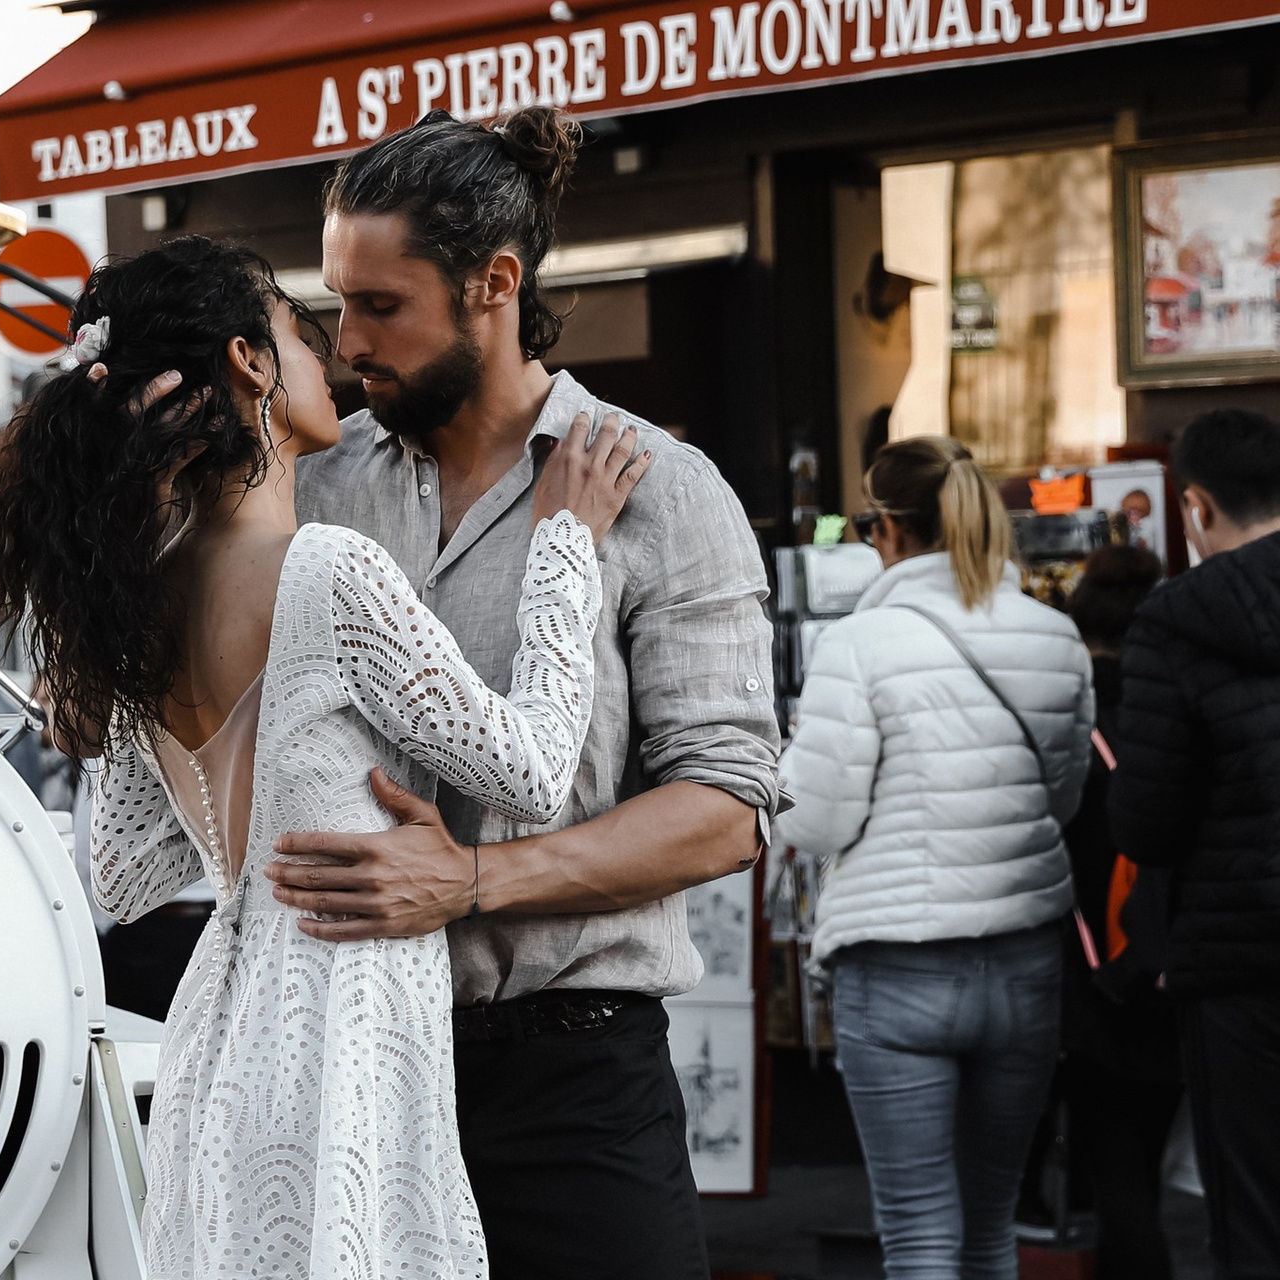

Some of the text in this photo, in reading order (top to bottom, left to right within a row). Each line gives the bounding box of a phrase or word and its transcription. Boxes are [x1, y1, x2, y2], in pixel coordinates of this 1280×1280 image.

[32, 103, 259, 182] TABLEAUX
[312, 76, 348, 147] A
[412, 27, 607, 124] PIERRE
[620, 12, 697, 97] DE
